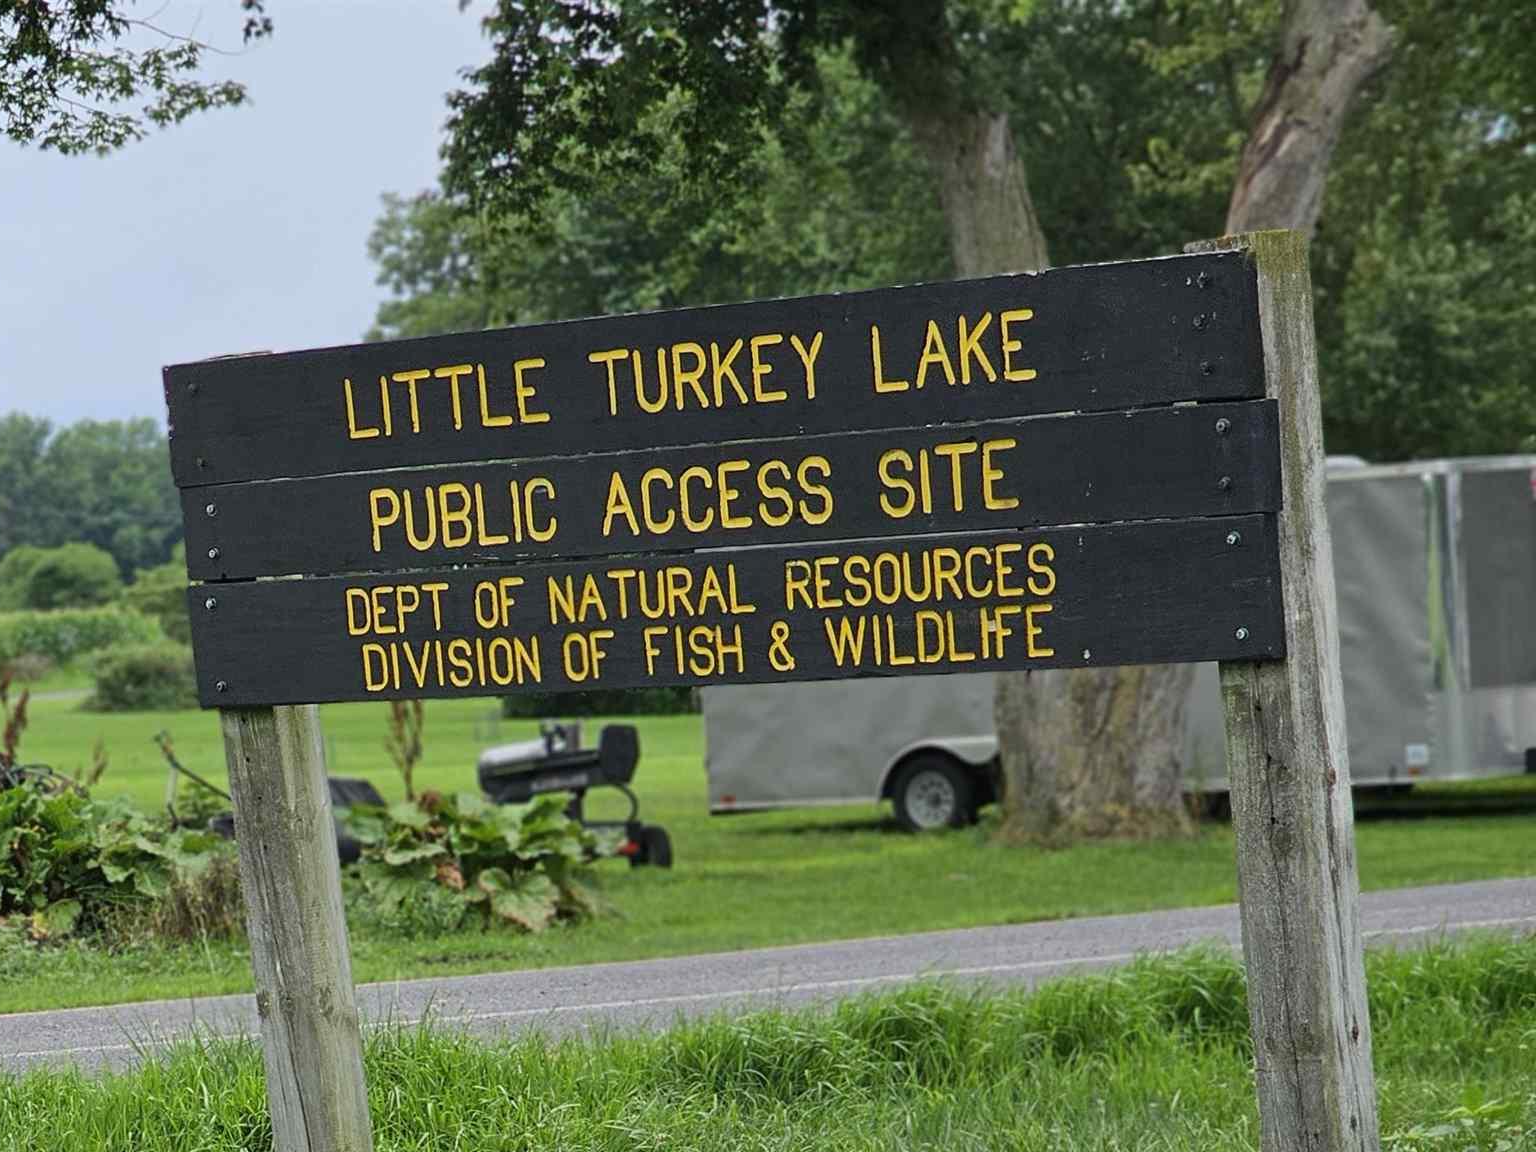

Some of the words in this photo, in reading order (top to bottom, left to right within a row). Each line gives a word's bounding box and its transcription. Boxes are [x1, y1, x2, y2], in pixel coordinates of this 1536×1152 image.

[343, 357, 551, 440] LITTLE
[588, 329, 825, 417] TURKEY
[870, 308, 1037, 394] LAKE
[368, 476, 558, 553] PUBLIC
[601, 454, 835, 536] ACCESS
[877, 437, 1021, 519] SITE
[345, 582, 449, 636] DEPT
[474, 576, 525, 630] OF
[547, 563, 757, 625] NATURAL
[784, 543, 1057, 611] RESOURCES
[361, 635, 543, 692] DIVISION
[563, 628, 614, 683] OF
[643, 624, 745, 678] FISH
[767, 620, 797, 672] &
[824, 603, 1055, 667] WILDLIFE
